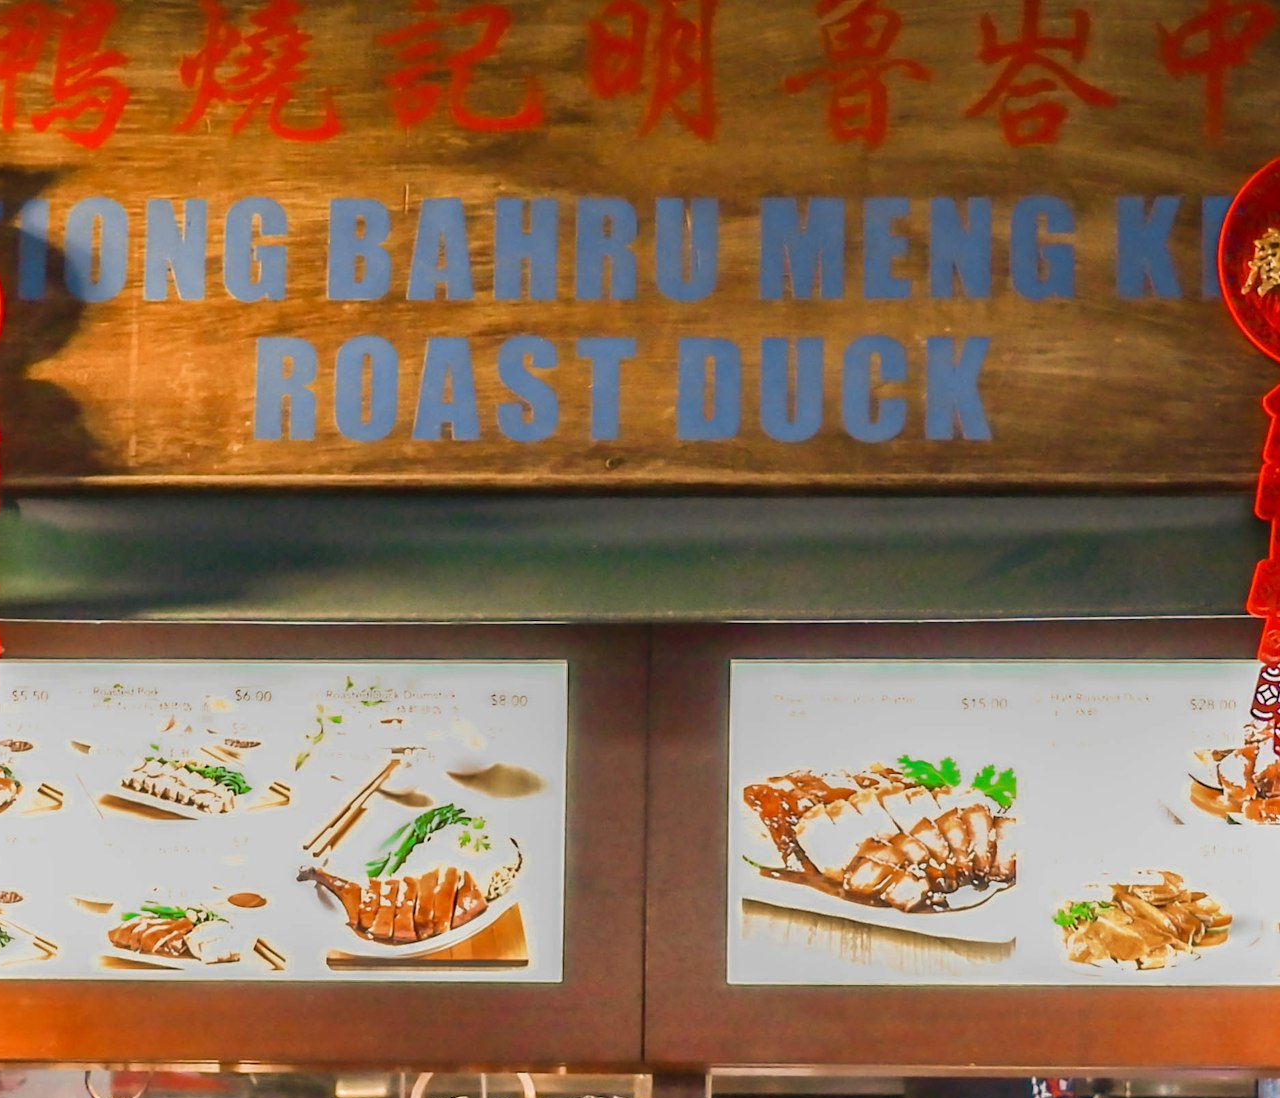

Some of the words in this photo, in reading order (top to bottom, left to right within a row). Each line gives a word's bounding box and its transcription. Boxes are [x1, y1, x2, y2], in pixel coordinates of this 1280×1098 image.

[327, 196, 717, 302] BAHRU
[759, 196, 1075, 300] MENG
[254, 336, 635, 442] ROAST
[677, 336, 992, 442] DUCK
